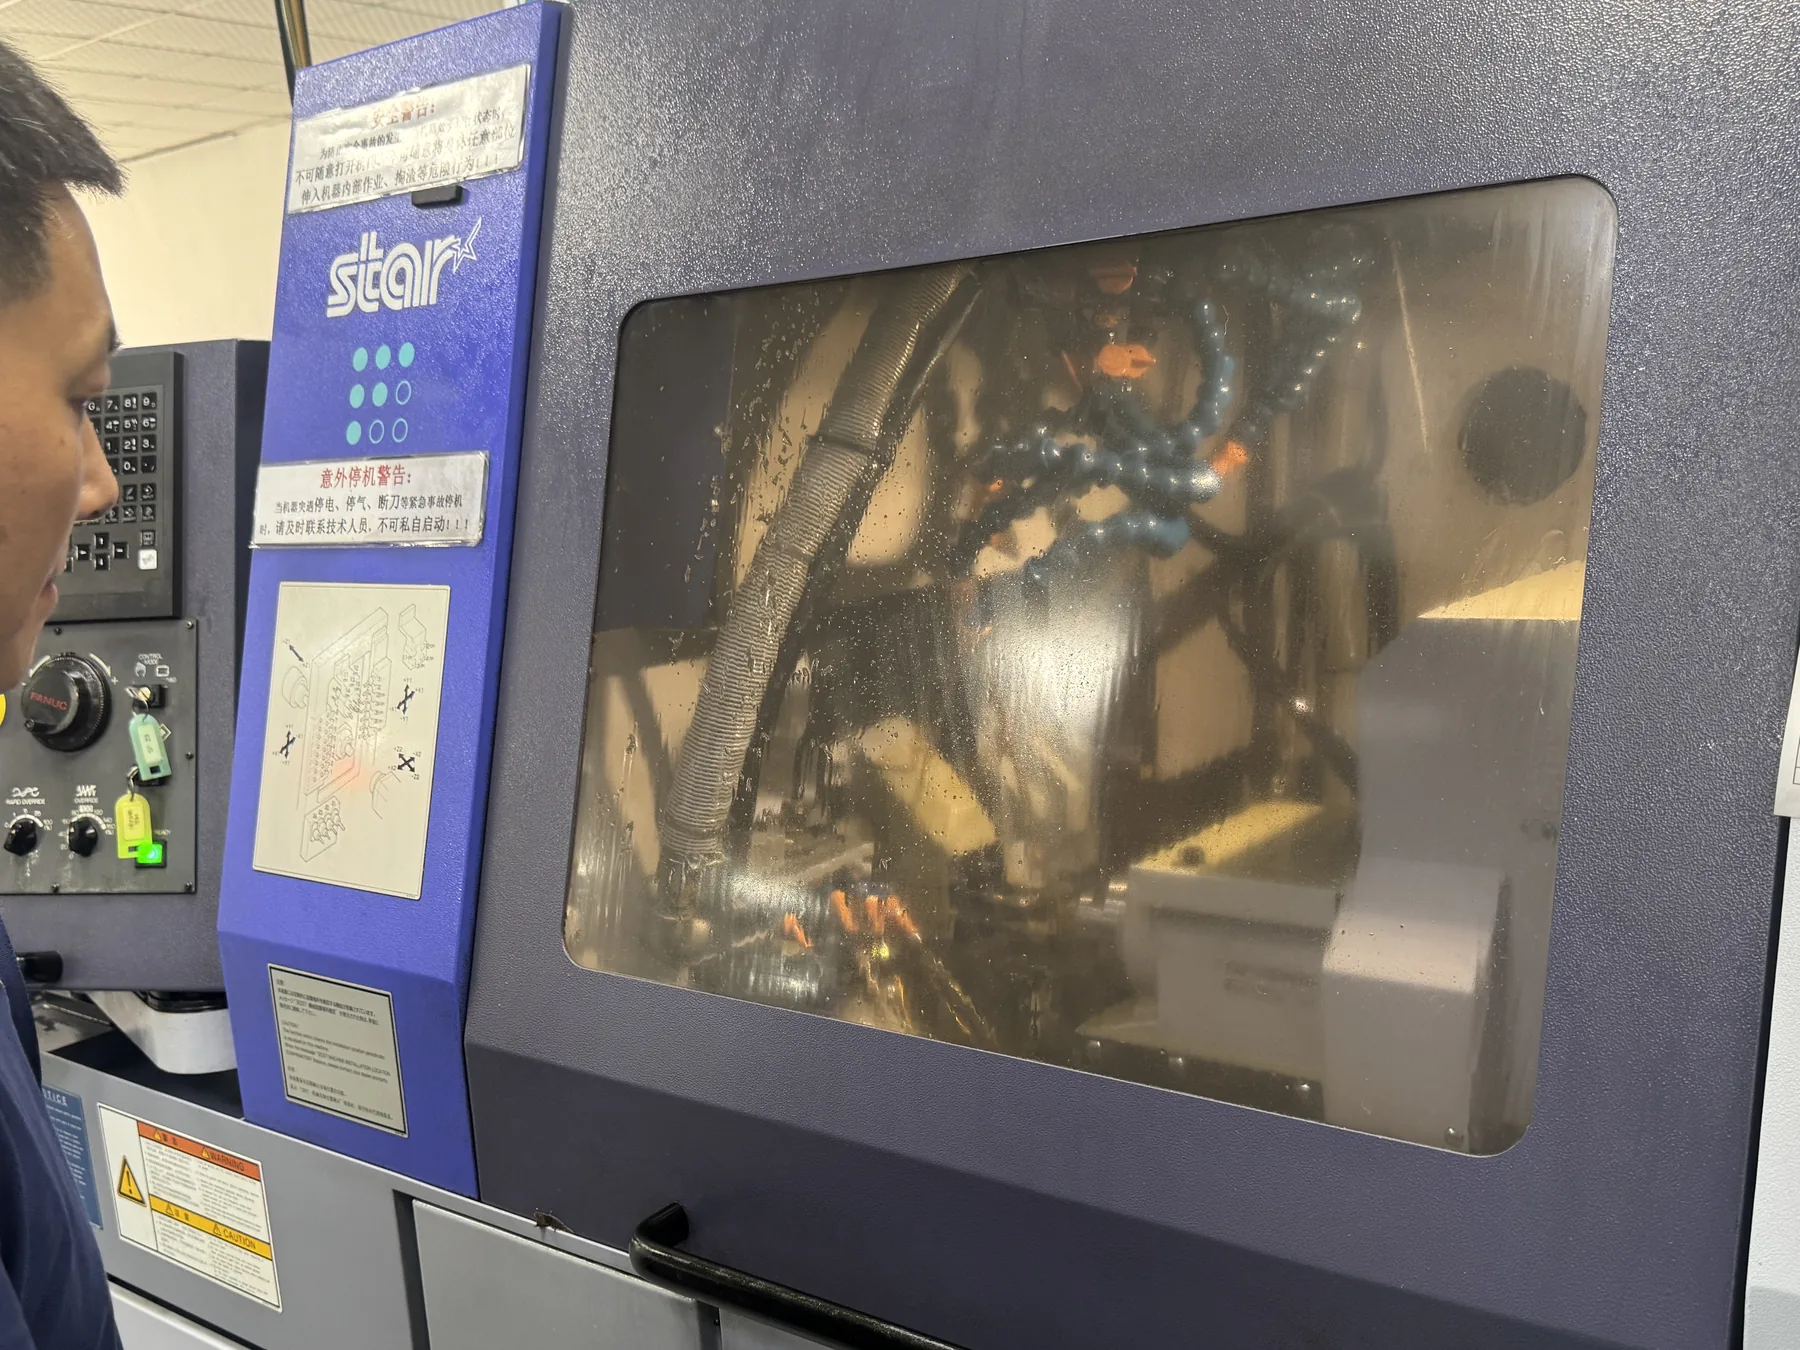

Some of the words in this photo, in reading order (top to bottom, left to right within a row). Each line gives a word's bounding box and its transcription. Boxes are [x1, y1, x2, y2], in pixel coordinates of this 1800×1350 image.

[29, 691, 69, 711] FANUC
[210, 1152, 245, 1172] WARNING
[222, 1229, 256, 1250] CAUTION
